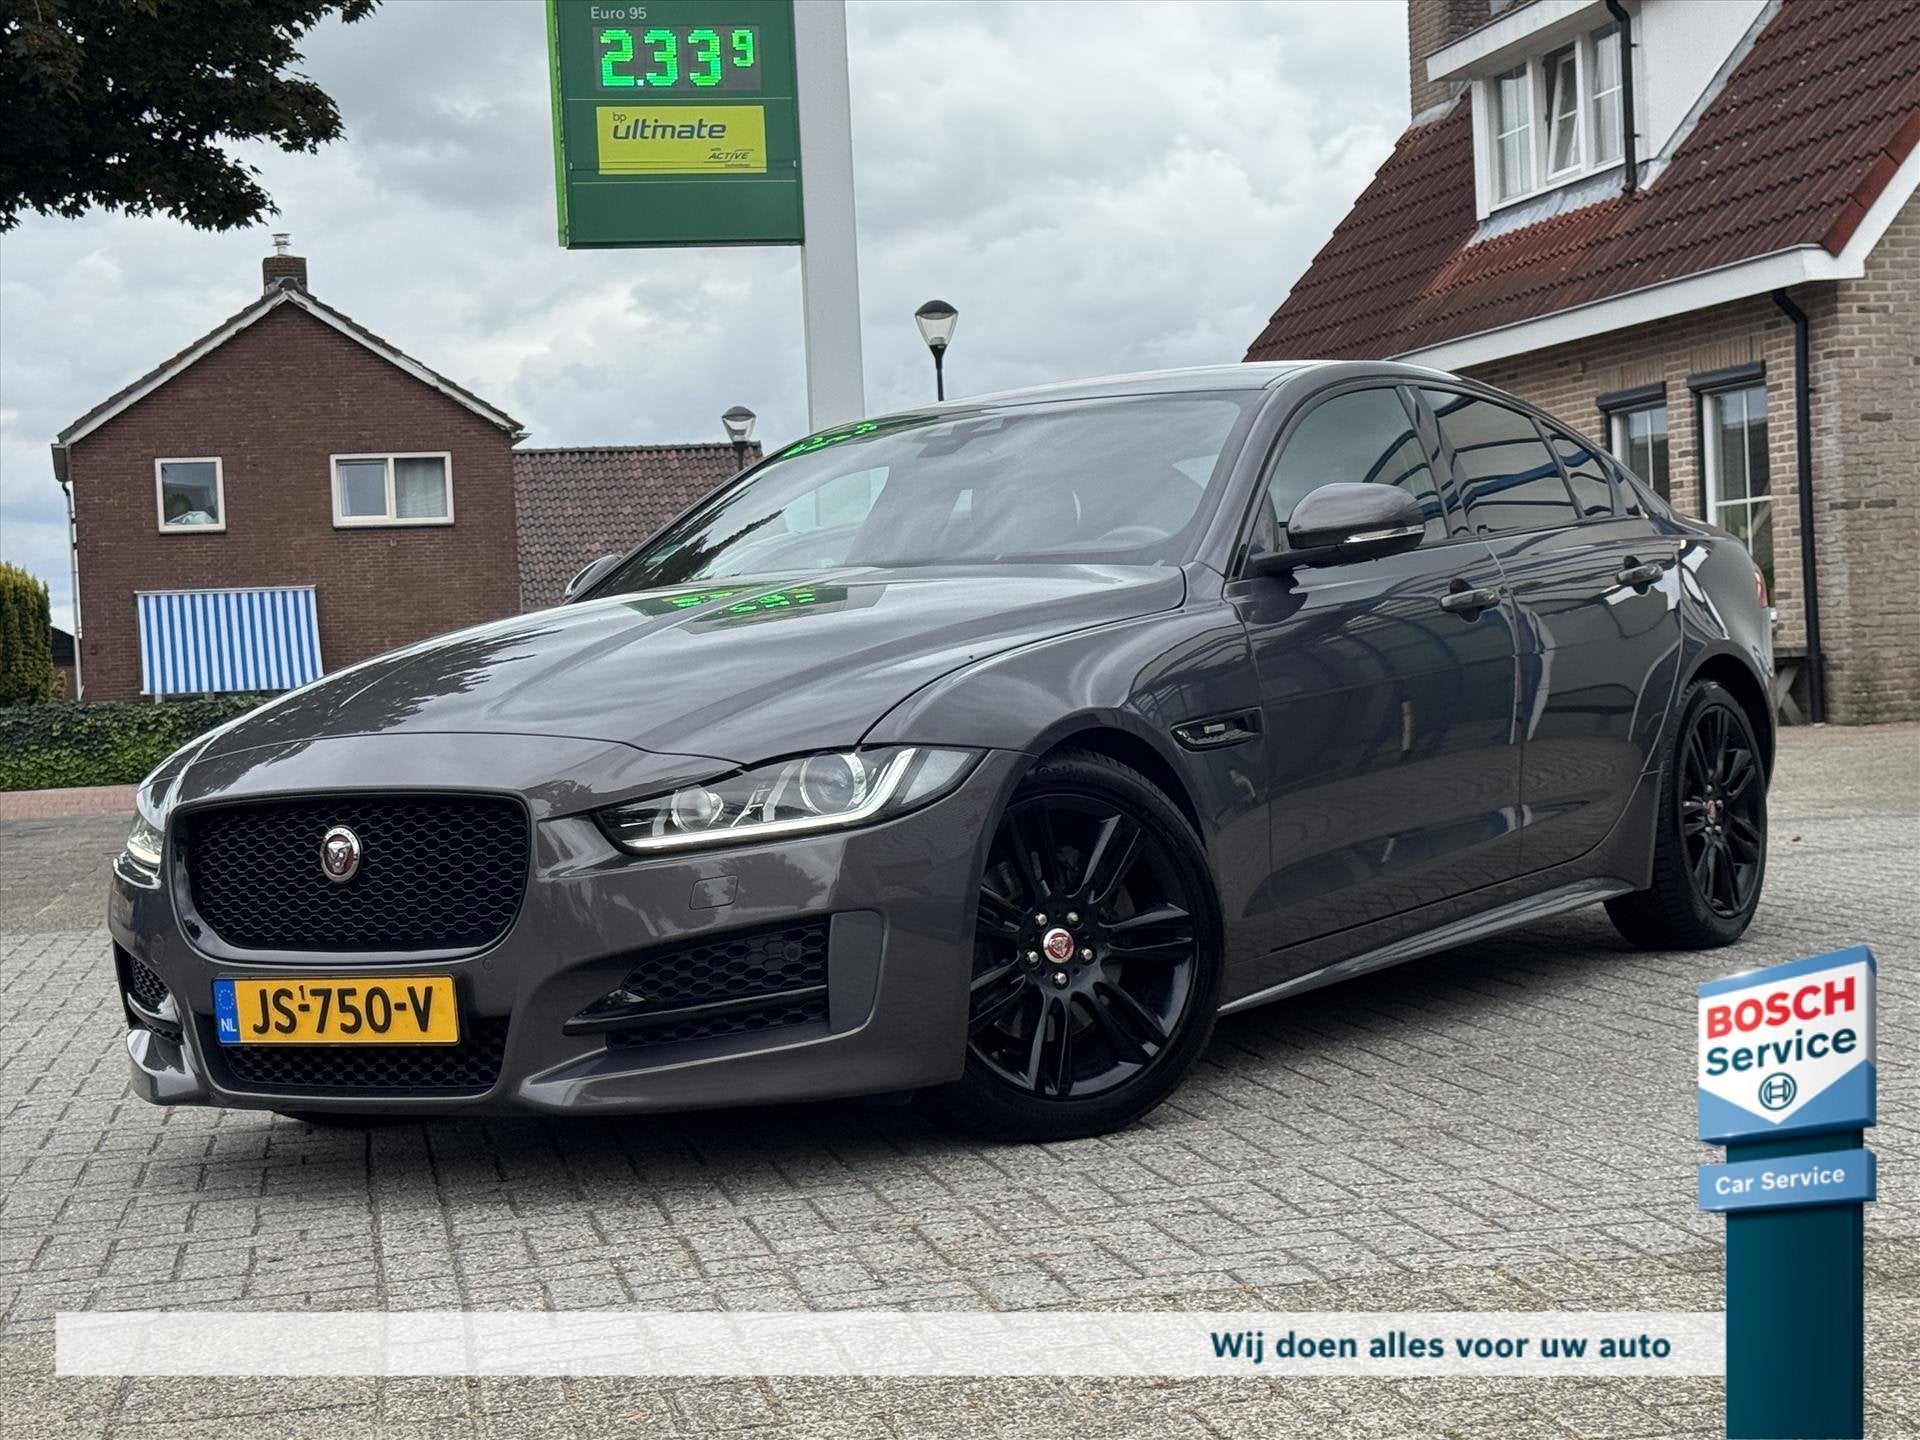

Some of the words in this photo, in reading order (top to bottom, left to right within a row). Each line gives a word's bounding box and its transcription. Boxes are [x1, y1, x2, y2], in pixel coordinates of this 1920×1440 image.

[590, 6, 626, 20] Euro
[629, 6, 647, 20] 95
[612, 112, 627, 124] bp
[612, 118, 727, 140] ultimate
[707, 151, 751, 161] ACTIVE
[253, 985, 433, 1034] JS-750-V
[221, 1018, 237, 1033] NL
